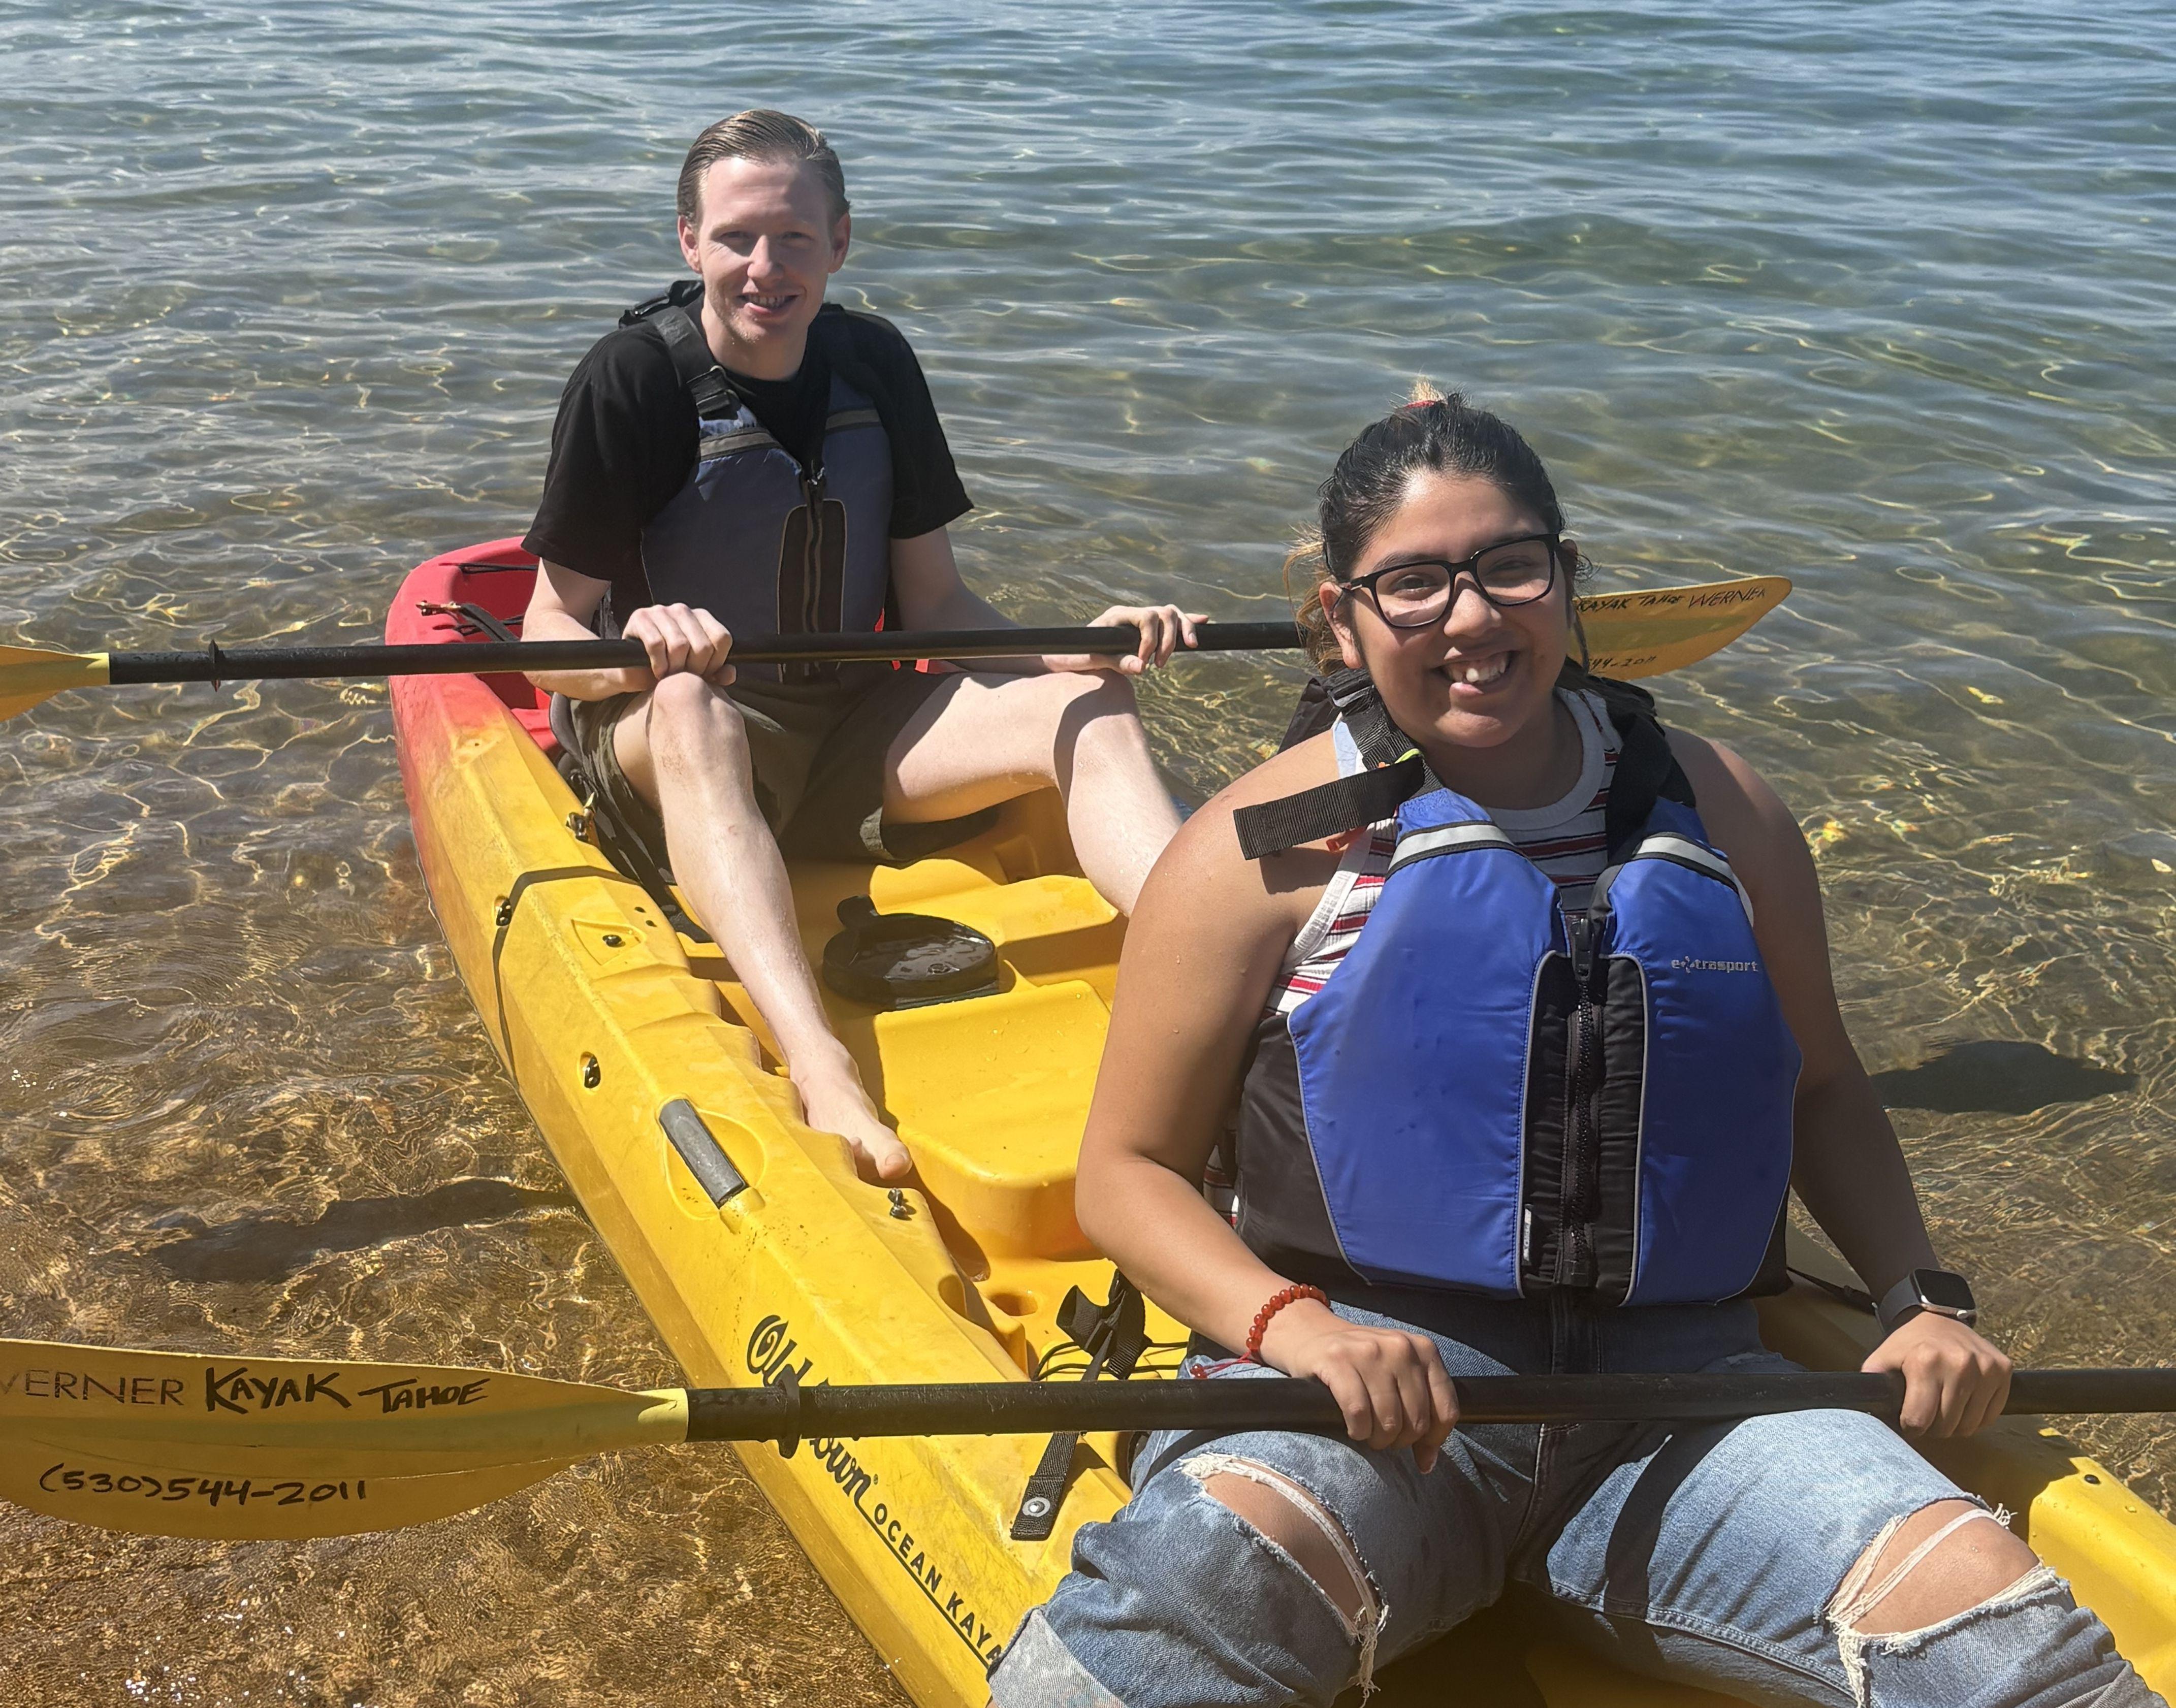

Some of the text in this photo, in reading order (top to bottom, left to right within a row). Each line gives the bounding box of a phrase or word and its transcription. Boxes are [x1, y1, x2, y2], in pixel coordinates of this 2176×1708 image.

[1688, 587, 1766, 609] WERNER
[206, 1367, 351, 1414] KAYAK
[358, 1378, 491, 1412] TAHOE
[40, 1463, 365, 1506] (530)544-2011
[874, 1503, 942, 1594] OCEAN
[946, 1591, 1001, 1660] KAYA
